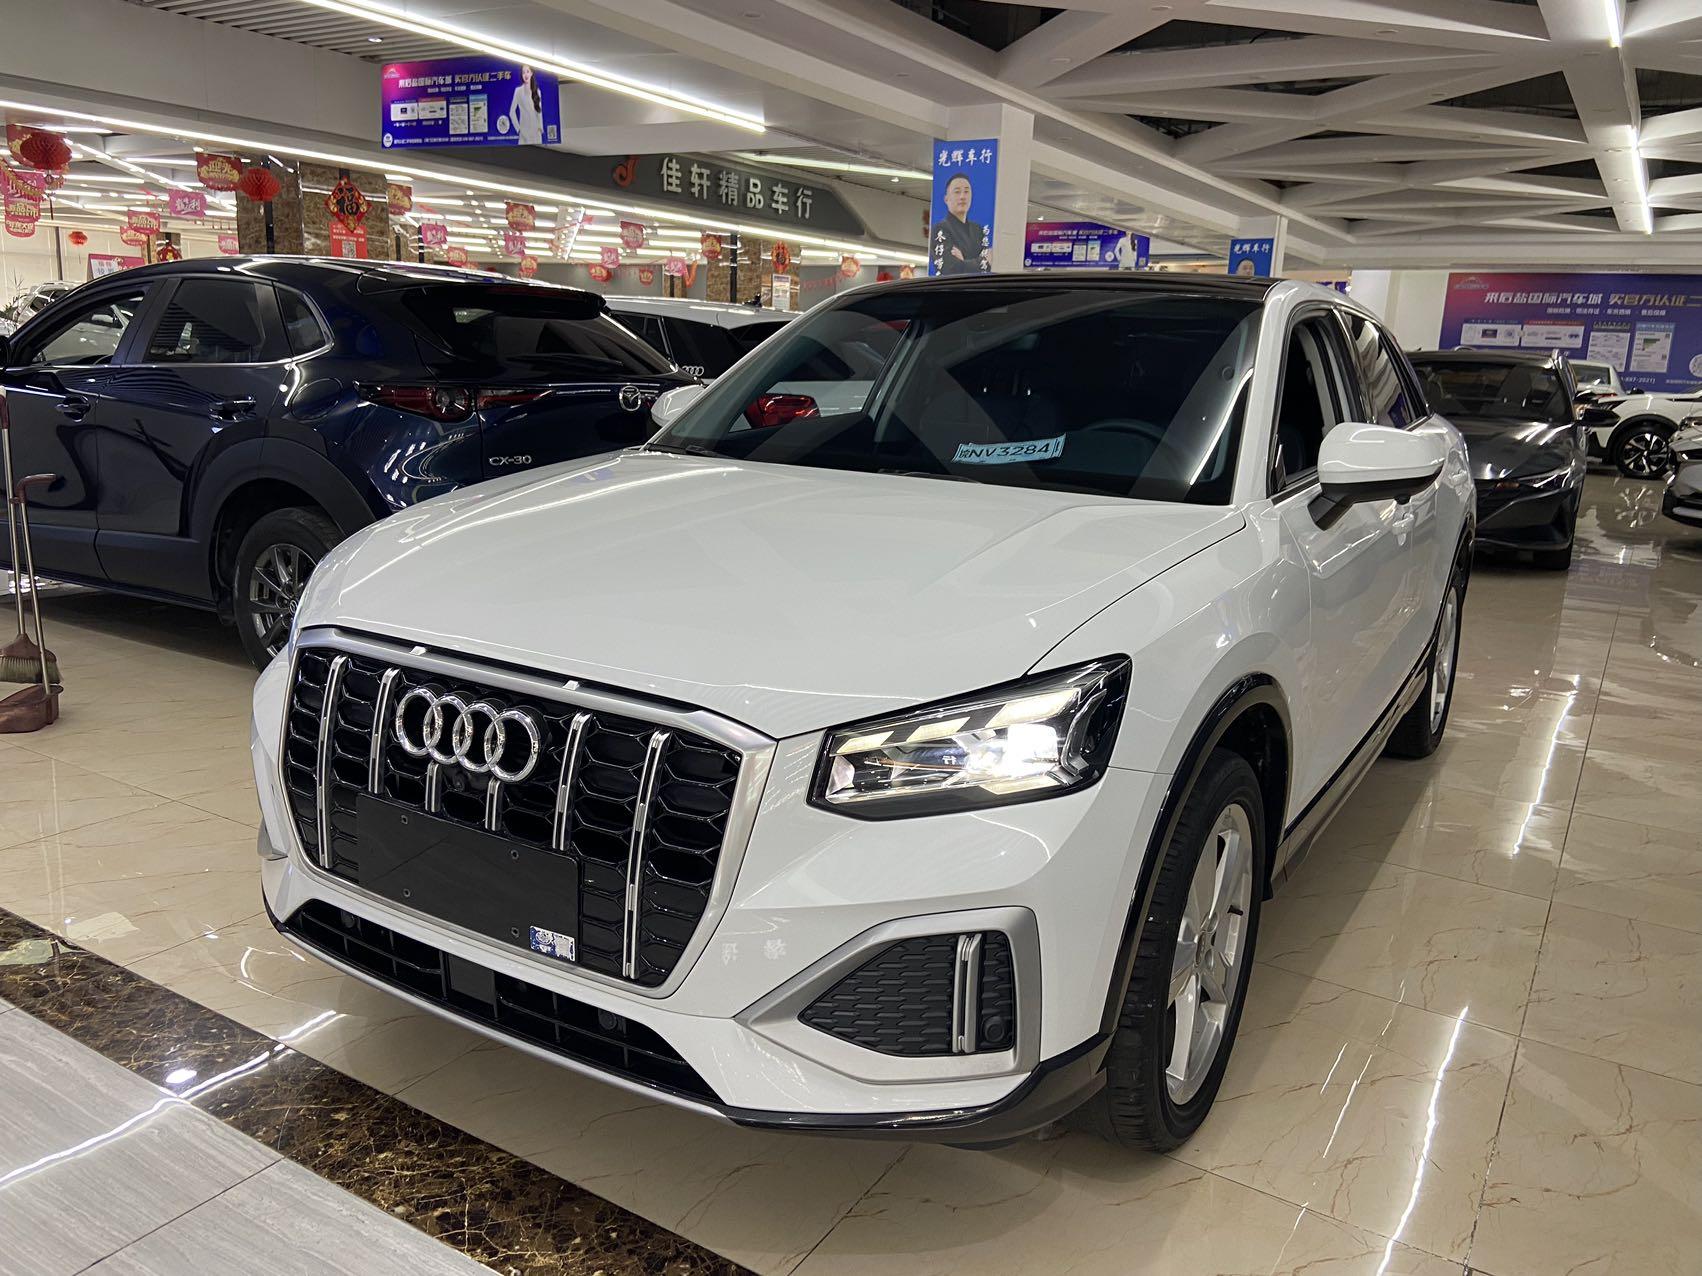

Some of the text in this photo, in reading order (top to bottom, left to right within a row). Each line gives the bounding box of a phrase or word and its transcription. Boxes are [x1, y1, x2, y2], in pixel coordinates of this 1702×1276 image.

[660, 156, 813, 219] 佳轩精品车行
[489, 455, 532, 466] CX-30
